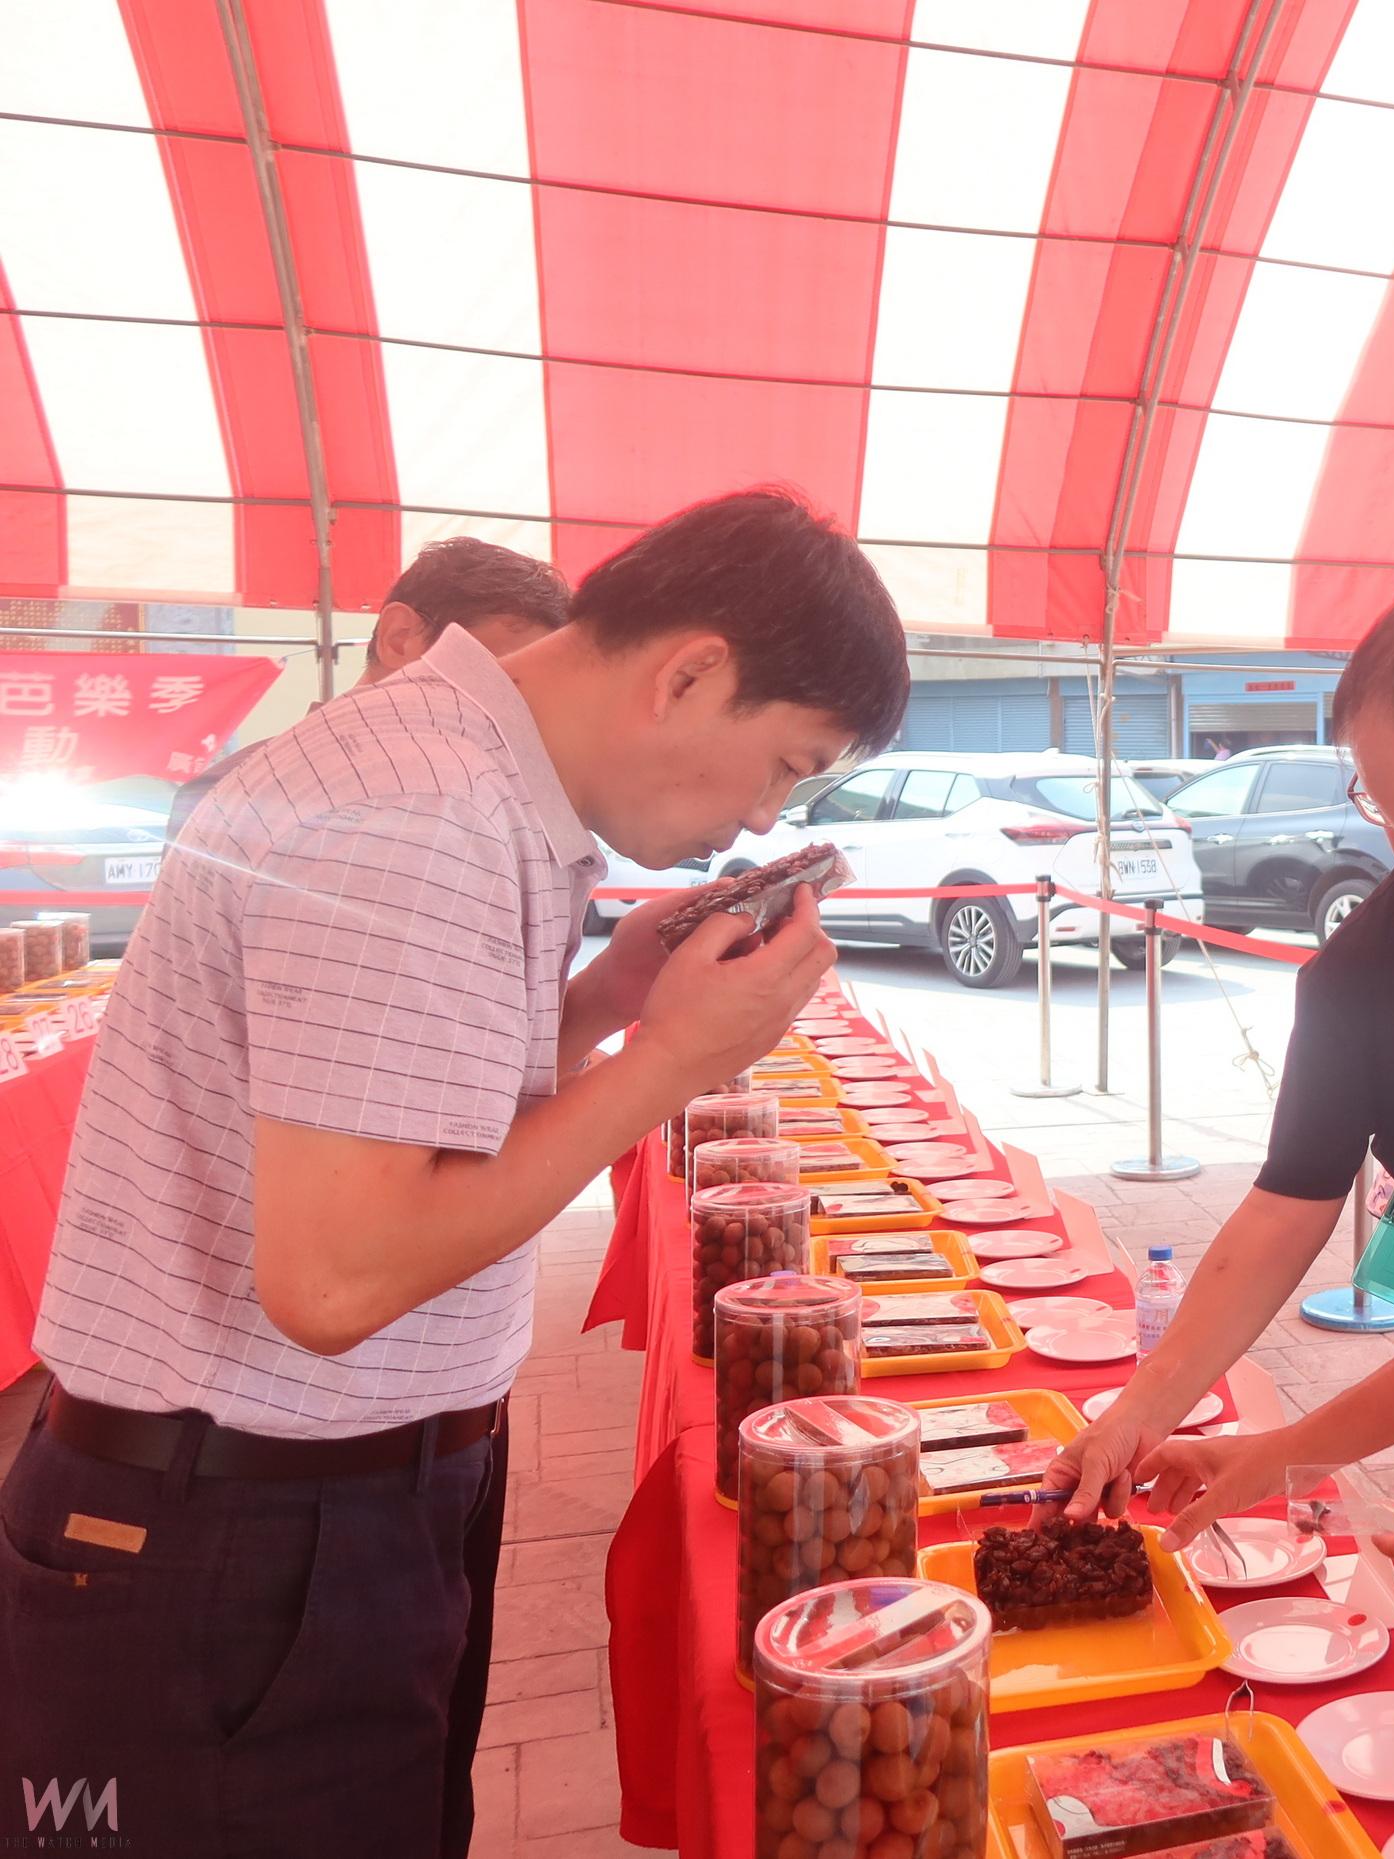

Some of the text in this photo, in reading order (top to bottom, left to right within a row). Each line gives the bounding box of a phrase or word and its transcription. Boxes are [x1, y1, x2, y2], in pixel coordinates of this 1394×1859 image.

[0, 672, 205, 717] 芭樂季
[66, 1001, 94, 1034] 26
[0, 1038, 19, 1075] 8
